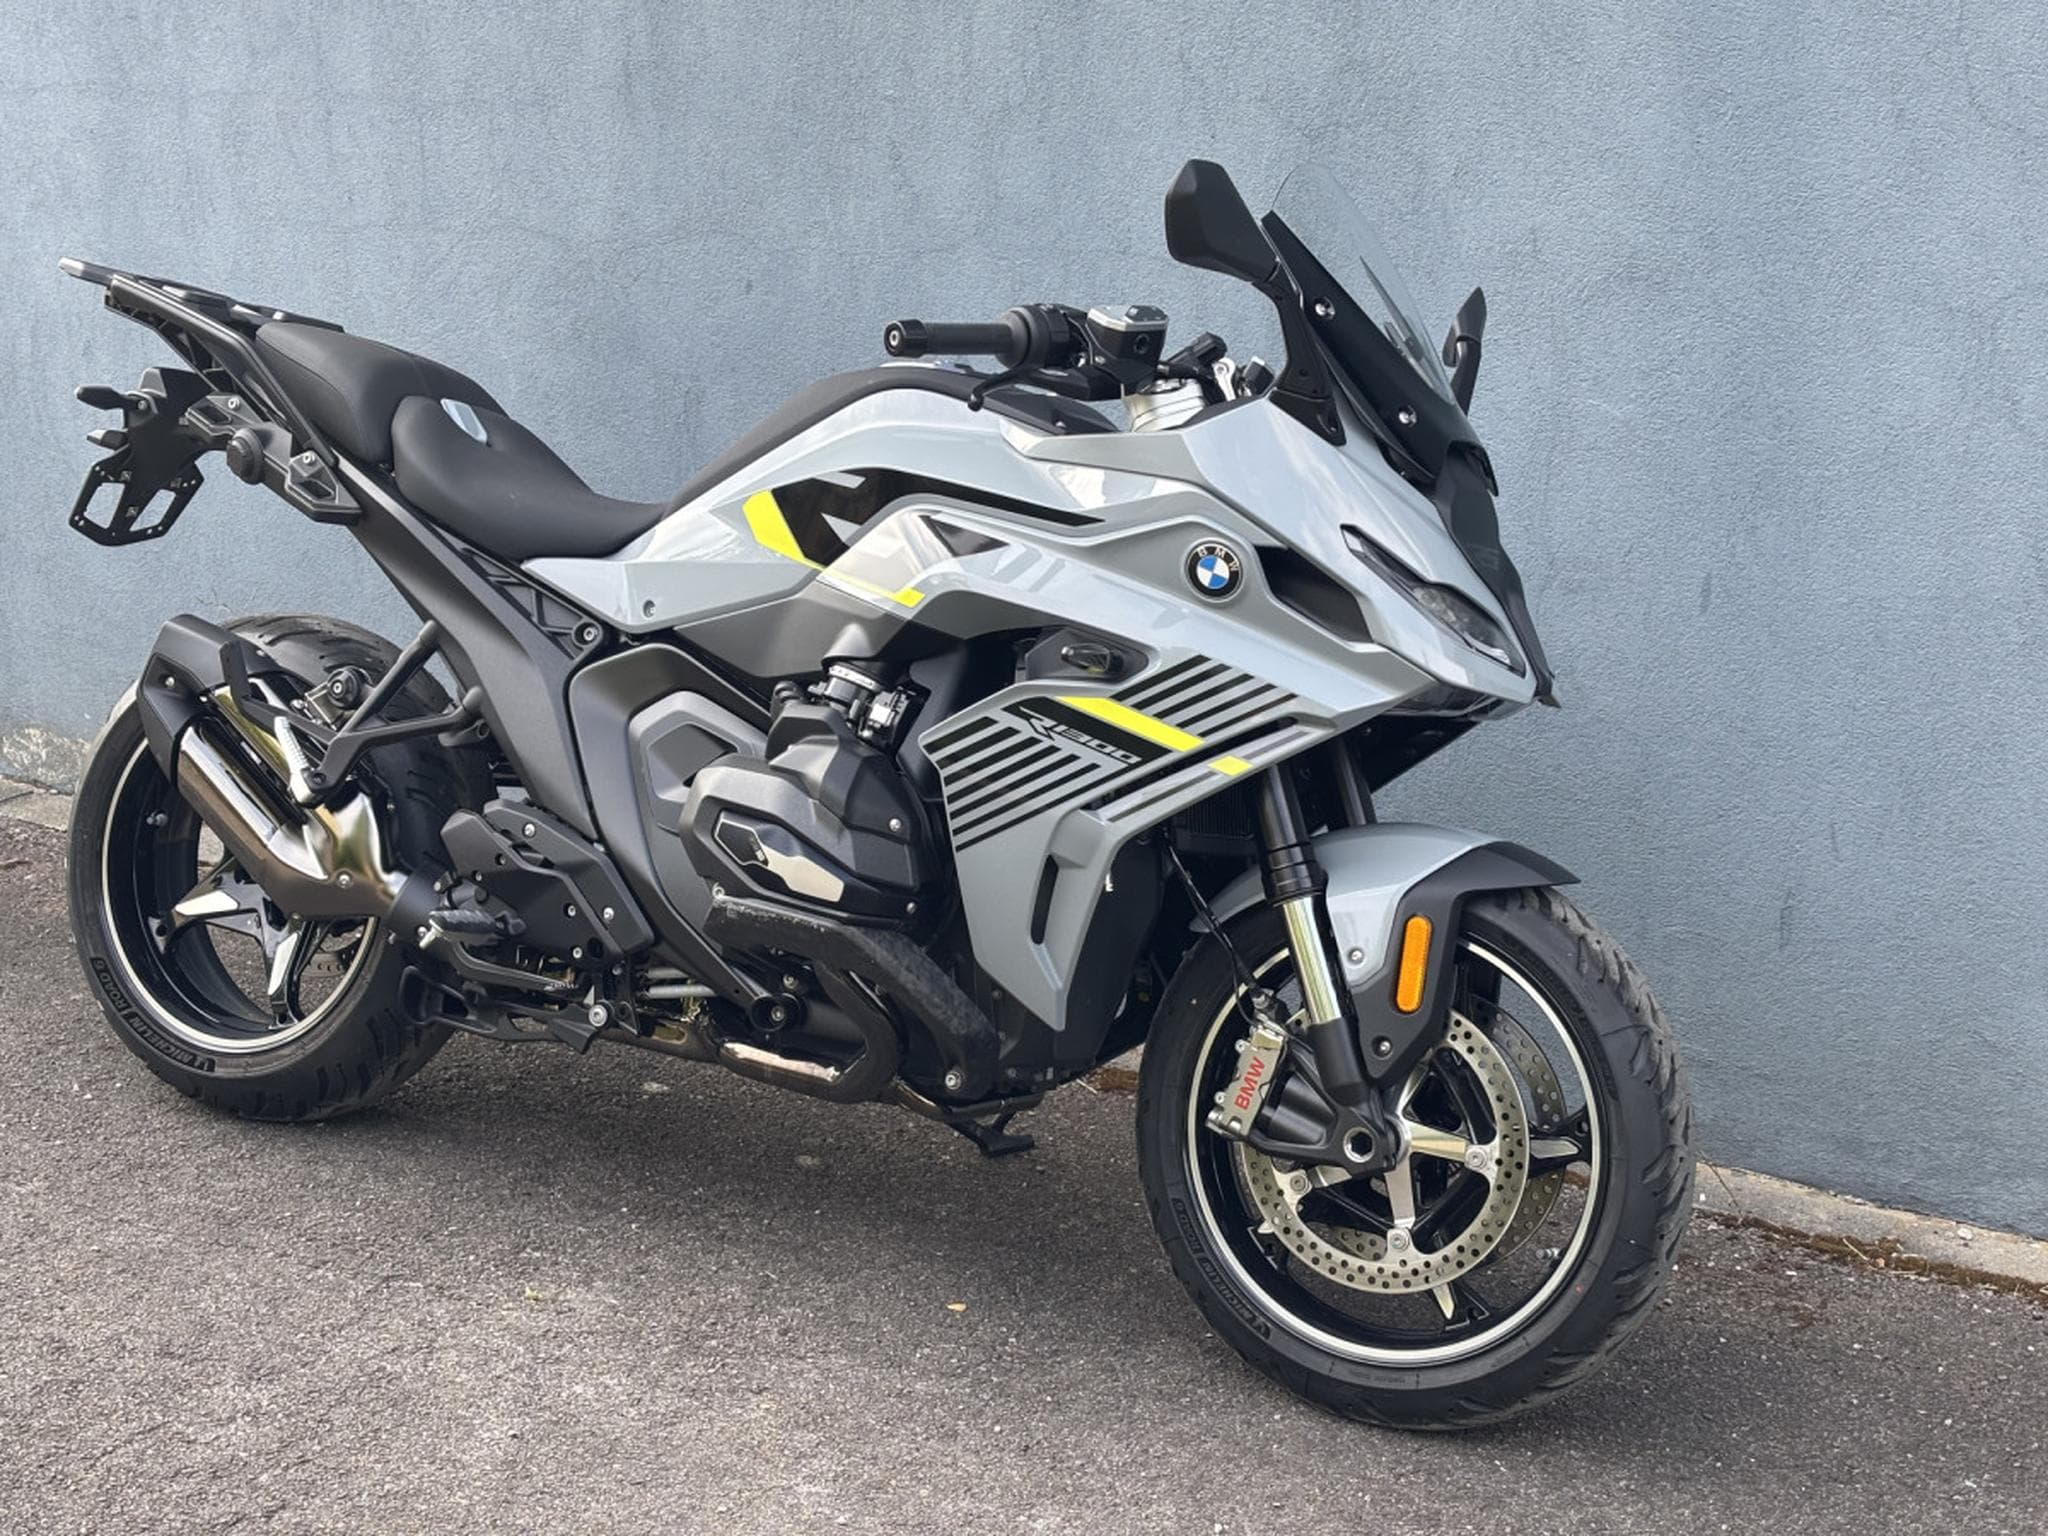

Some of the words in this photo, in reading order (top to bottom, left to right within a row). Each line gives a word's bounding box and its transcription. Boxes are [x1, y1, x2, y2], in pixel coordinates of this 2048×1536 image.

[100, 972, 129, 1011] ROAD
[129, 1016, 195, 1063] MICHELIN
[1234, 1056, 1265, 1110] BMW
